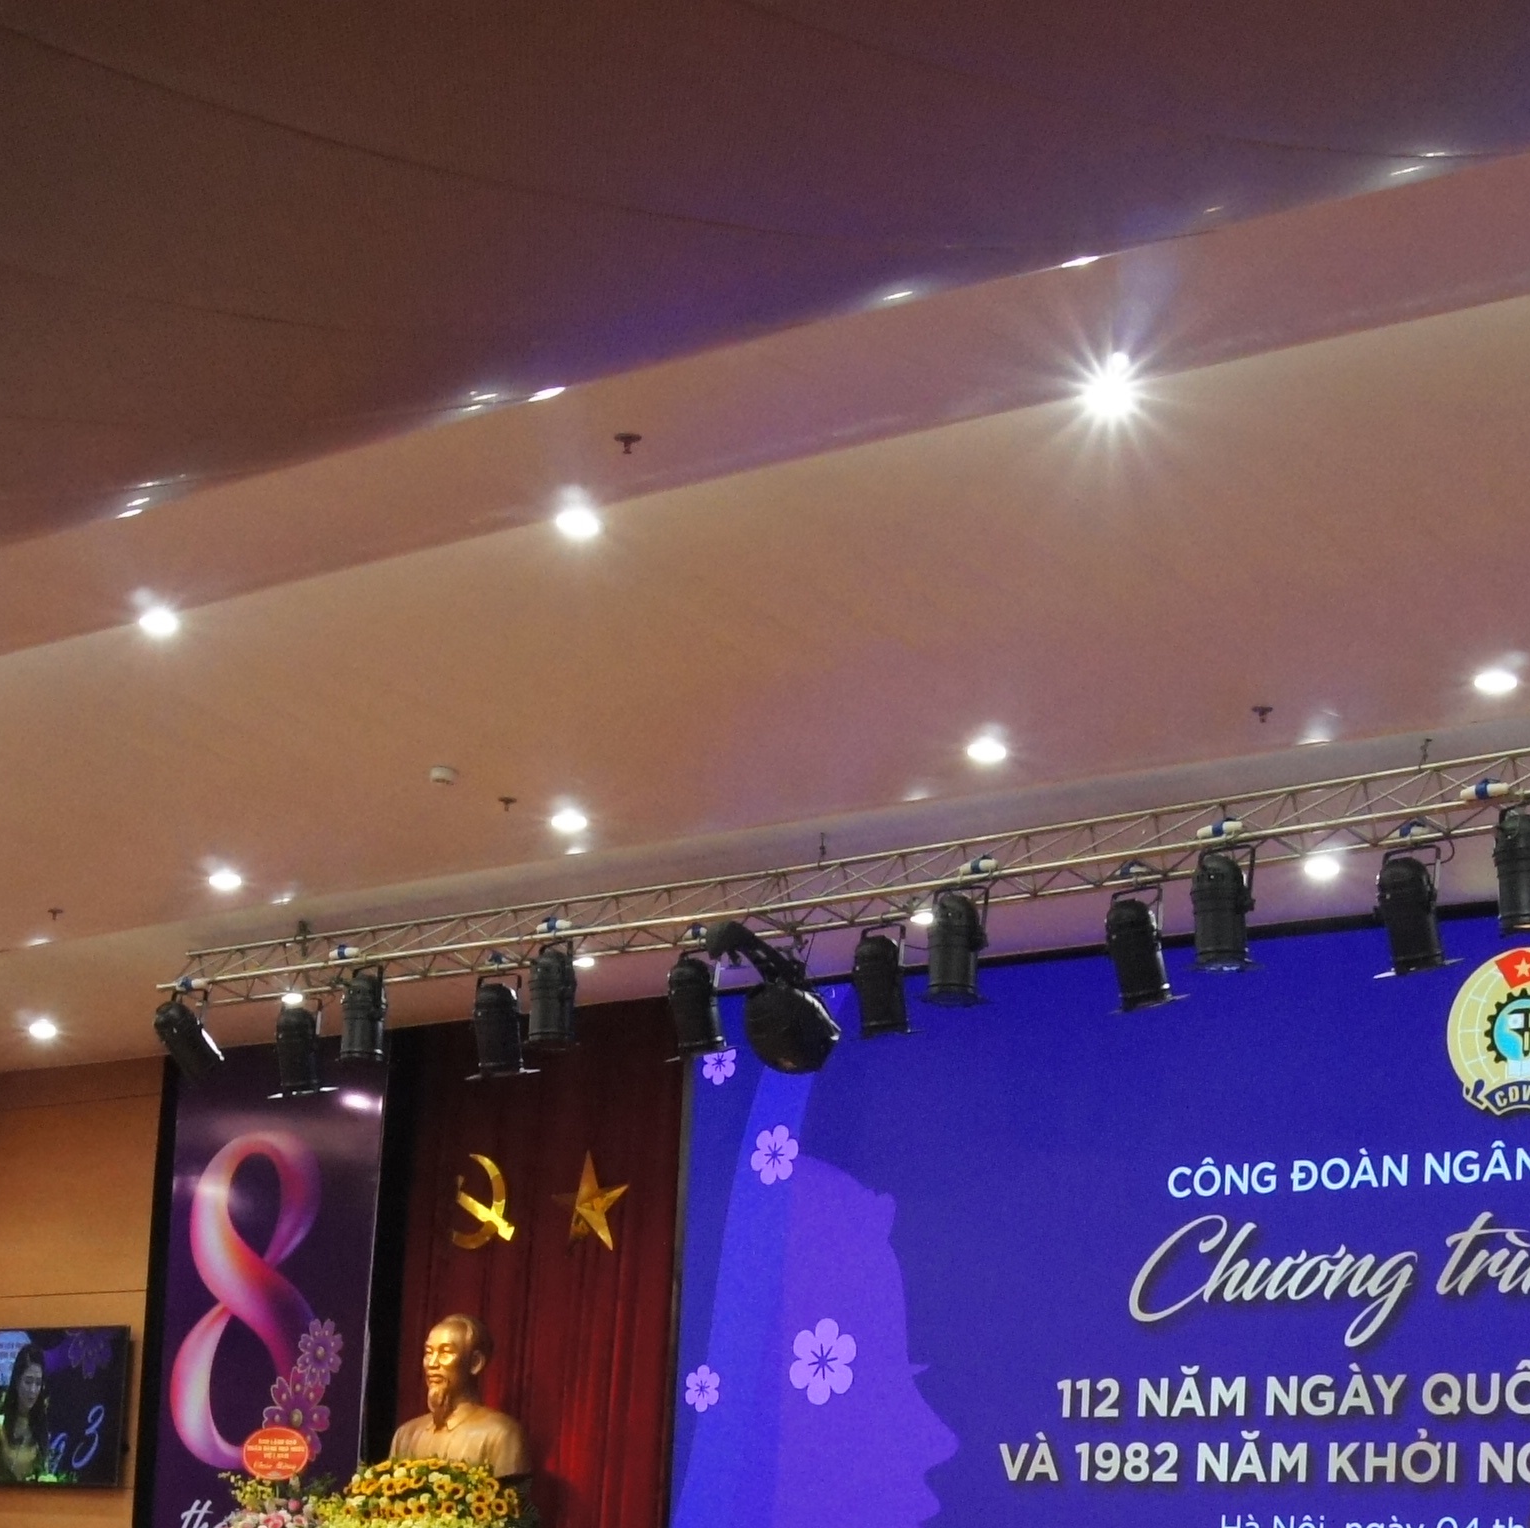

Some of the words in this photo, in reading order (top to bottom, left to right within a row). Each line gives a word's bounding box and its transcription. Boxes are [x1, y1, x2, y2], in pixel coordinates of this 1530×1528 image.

[1167, 1157, 1277, 1198] CÔNG
[1291, 1149, 1409, 1192] ĐOÀN
[1129, 1214, 1418, 1347] Chương
[1057, 1377, 1120, 1418] 112
[1137, 1365, 1247, 1418] NĂM
[1265, 1363, 1407, 1417] NGÀY
[999, 1432, 1059, 1482] VÀ
[1074, 1441, 1179, 1483] 1982
[1196, 1430, 1308, 1483] NĂM
[1327, 1428, 1457, 1483] KHỞI
